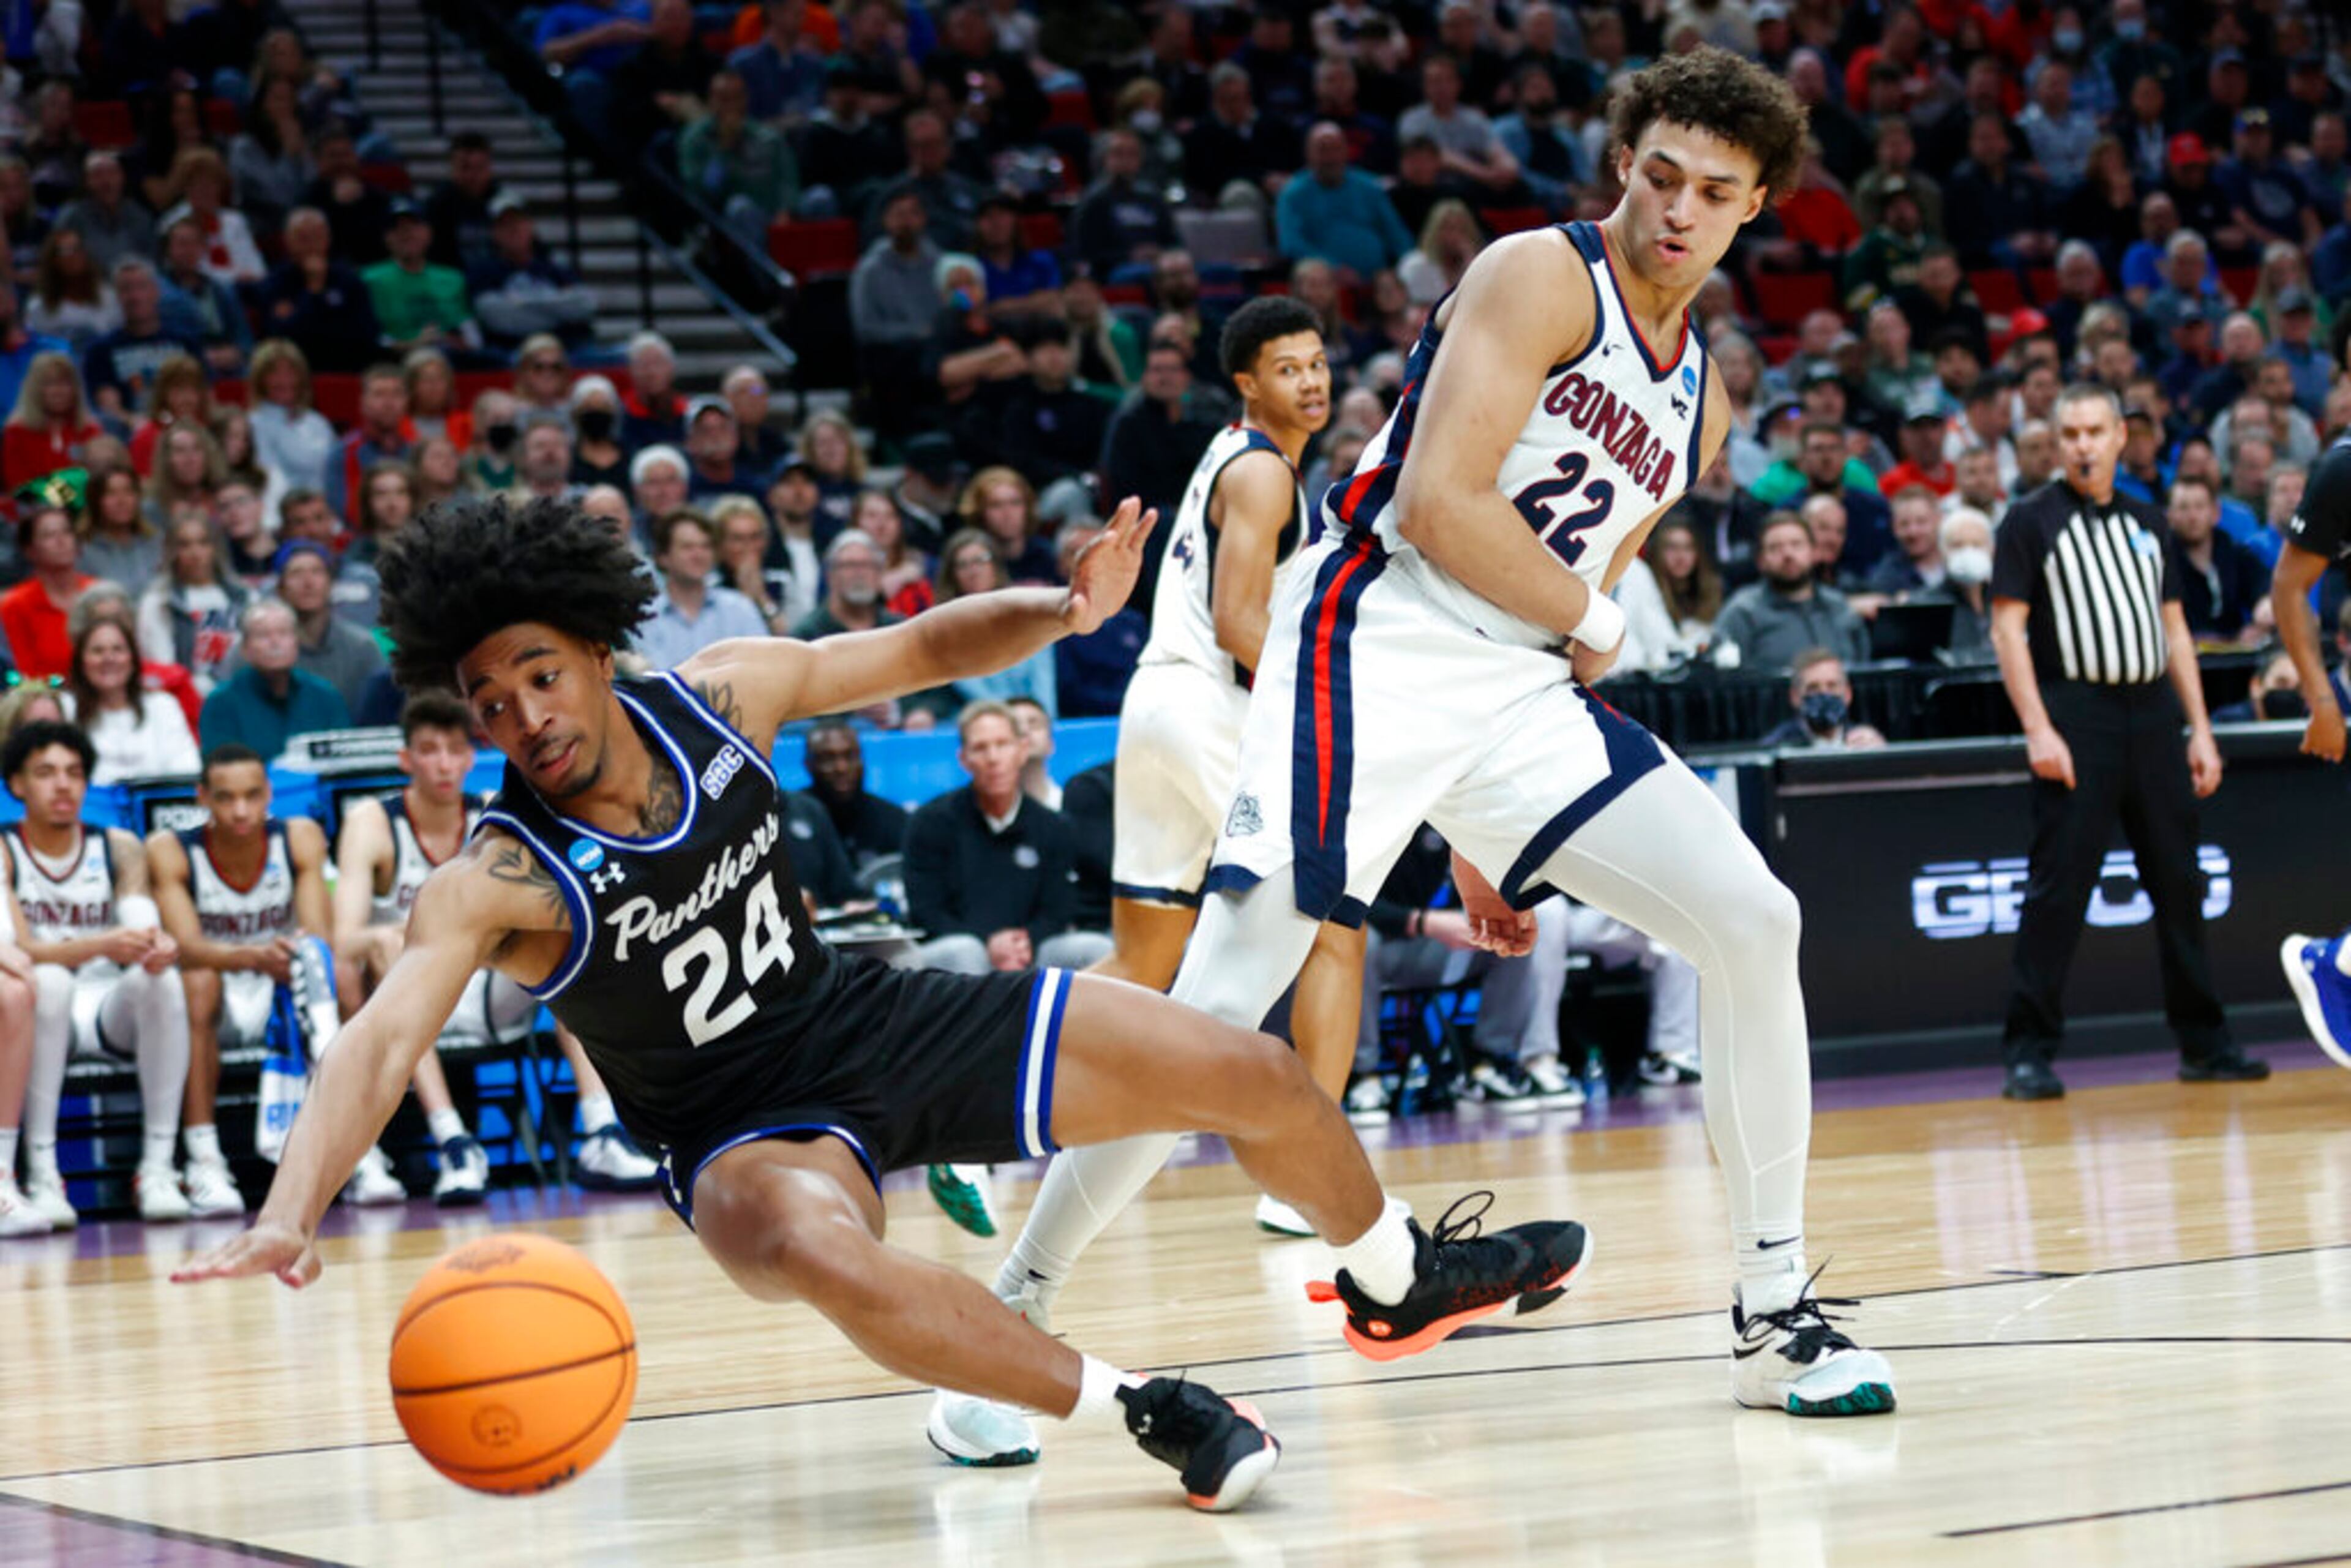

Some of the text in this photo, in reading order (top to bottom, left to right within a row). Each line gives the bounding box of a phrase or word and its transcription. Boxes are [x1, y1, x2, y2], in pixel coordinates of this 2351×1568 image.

[1543, 372, 1676, 503] GONZAGA
[1515, 451, 1615, 568] 22
[604, 812, 779, 961] Panthers
[1911, 845, 2232, 940] GEC
[661, 871, 795, 1048] 24
